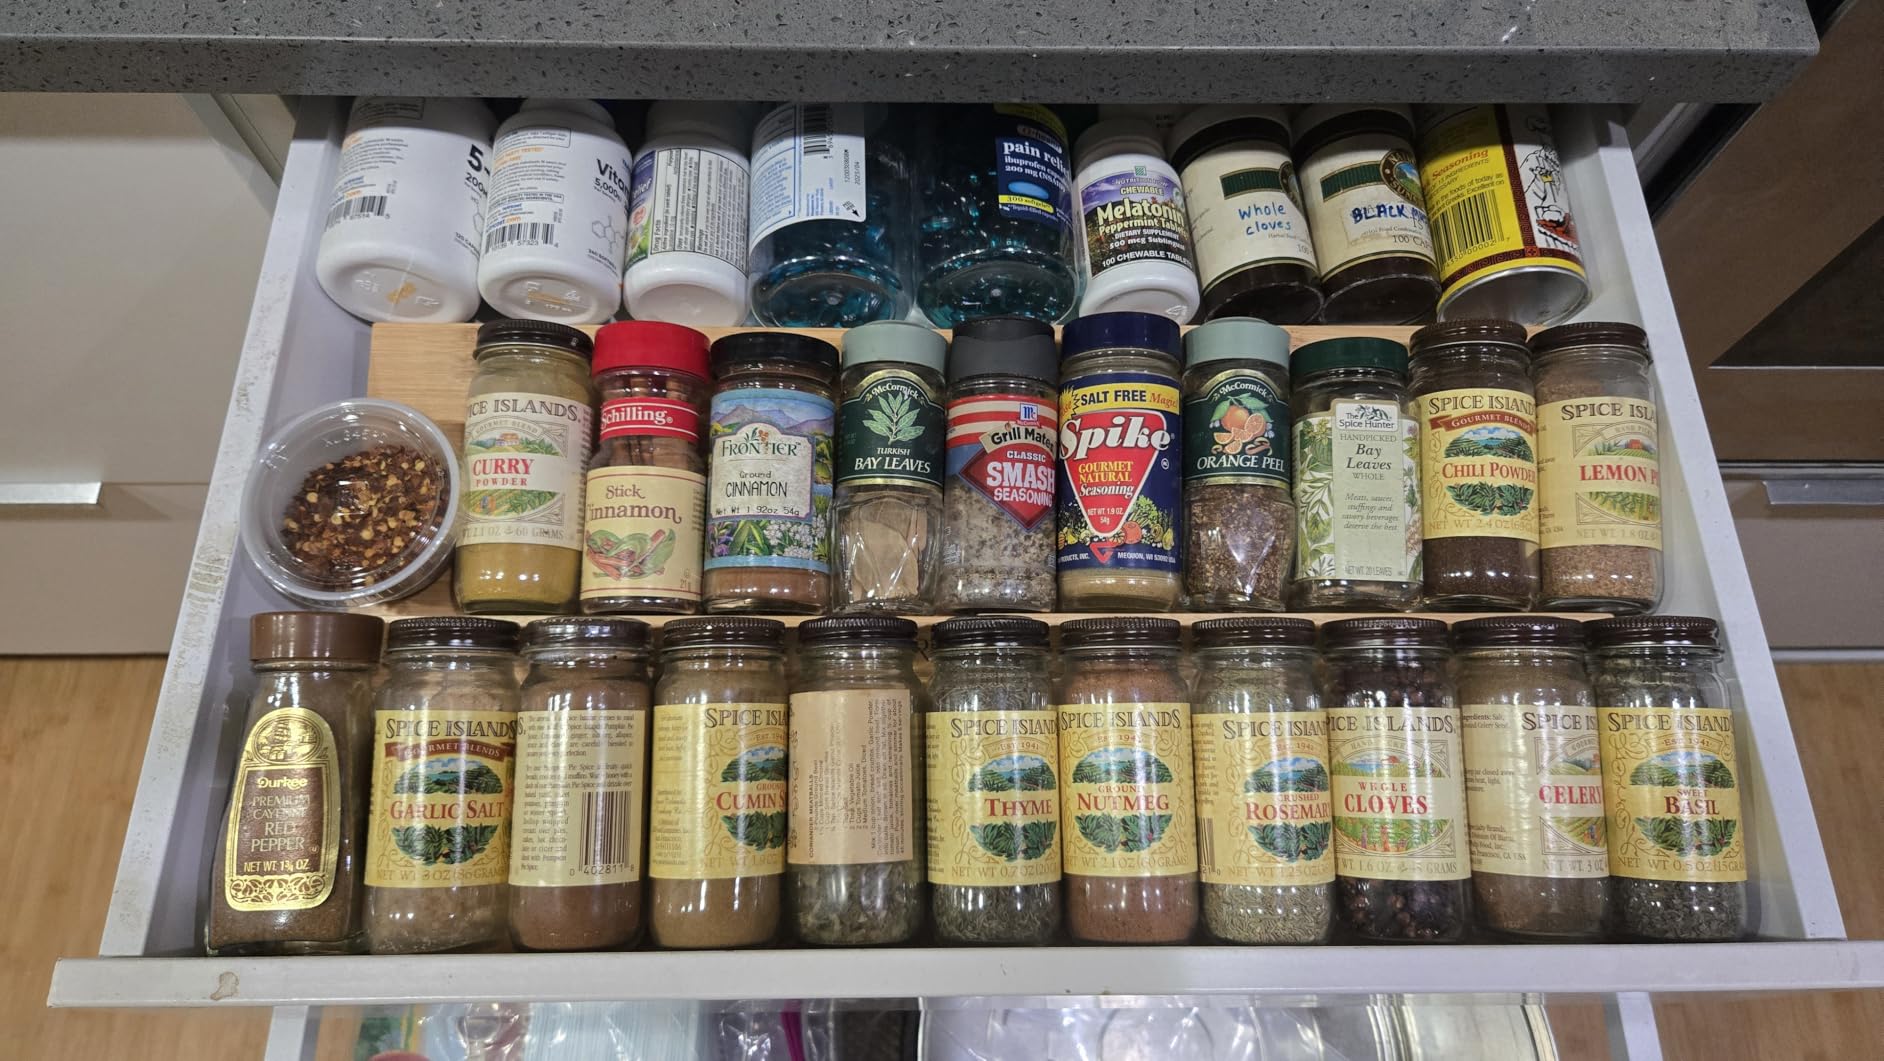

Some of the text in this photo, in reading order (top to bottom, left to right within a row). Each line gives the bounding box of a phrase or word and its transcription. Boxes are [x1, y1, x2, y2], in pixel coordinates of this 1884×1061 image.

[1003, 141, 1041, 158] pain
[1005, 155, 1046, 172] ibuprofen
[1005, 165, 1039, 178] 200 mg
[1433, 149, 1488, 180] Seasoning
[1445, 159, 1489, 180] INGREDIENTS
[1120, 186, 1164, 196] CHEWABLE
[1449, 183, 1466, 193] foods
[1475, 176, 1494, 185] today
[1466, 182, 1495, 194] Excellent
[1097, 198, 1185, 227] Melatonin
[1238, 201, 1287, 221] Whole
[1351, 203, 1409, 224] BLACK
[1098, 217, 1159, 237] Peppermint
[1114, 228, 1142, 240] DIETARY
[1109, 237, 1146, 250] 500 mcg
[1393, 234, 1410, 243] 100
[1102, 257, 1116, 268] 100
[1116, 250, 1165, 262] CHEWABLE
[872, 382, 919, 400] McCormick
[1220, 381, 1267, 398] McCormick
[1081, 390, 1147, 406] SALT FREE
[1429, 395, 1535, 416] SPICE ISLAND
[1561, 403, 1623, 421] SPICE
[1339, 420, 1395, 429] Spice Hunter
[1451, 414, 1532, 432] GOURMET BLENDS
[991, 427, 1020, 445] Grill
[1059, 415, 1171, 460] Spike
[1340, 433, 1397, 443] HANDPICKED
[722, 440, 798, 457] FRONTIER
[876, 447, 910, 455] TURKISH
[1007, 450, 1046, 462] CLASSIC
[1355, 443, 1382, 459] Bay
[473, 458, 534, 477] CURRY
[854, 457, 931, 473] BAY LEAVES
[1079, 461, 1133, 473] GOURMET
[1197, 455, 1285, 472] ORANGE PEEL
[1346, 457, 1393, 470] Leaves
[1442, 463, 1485, 479] CHILI
[739, 471, 773, 479] Ground
[986, 461, 1055, 494] SMASH
[1079, 471, 1132, 484] NATURAL
[1352, 472, 1385, 480] WHOLE
[1580, 464, 1648, 483] LEMON
[476, 478, 527, 487] POWDER
[726, 481, 788, 498] CINNAMON
[606, 485, 645, 500] Stick
[993, 487, 1053, 507] SEASONING
[1079, 483, 1134, 499] Seasoning
[715, 508, 726, 516] Net
[1347, 503, 1393, 513] stuffings and
[1100, 516, 1110, 526] 54g
[1343, 521, 1369, 530] deserve
[1370, 522, 1383, 530] the
[1366, 513, 1400, 523] beverages
[1430, 520, 1449, 530] NET
[1345, 566, 1355, 575] NET
[704, 708, 762, 728] SPICE
[1061, 711, 1104, 731] SPICE
[1522, 712, 1582, 731] SPICE
[1608, 712, 1732, 732] SPICE ISLAND
[386, 718, 441, 739] SPICE
[951, 718, 1057, 738] SPICE ISLAND
[1223, 719, 1284, 740] SPICE
[1021, 742, 1039, 750] 1941
[1688, 736, 1709, 747] 1941
[404, 742, 501, 759] GOURMET BLENDS
[256, 777, 308, 790] Durkee
[1358, 782, 1408, 792] WHOLE
[1676, 788, 1708, 797] SWEET
[251, 795, 310, 807] PREMIUM
[716, 792, 775, 811] CUMIN
[984, 798, 1052, 817] THYME
[1077, 793, 1169, 811] NUTMEG
[1344, 793, 1429, 815] CLOVES
[1665, 796, 1719, 816] BASIL
[253, 808, 307, 820] CAYENNE
[390, 800, 504, 820] GARLIC SALT
[265, 822, 297, 836] RED
[251, 837, 305, 852] PEPPER
[244, 861, 260, 872] NET
[583, 864, 624, 875] 402811
[951, 866, 971, 878] NET
[1228, 866, 1249, 877] NET
[1358, 859, 1374, 872] 1.6
[1426, 861, 1457, 875] GRAMS
[1617, 856, 1640, 868] NET
[1647, 857, 1669, 869] WT
[1695, 861, 1713, 873] OZ
